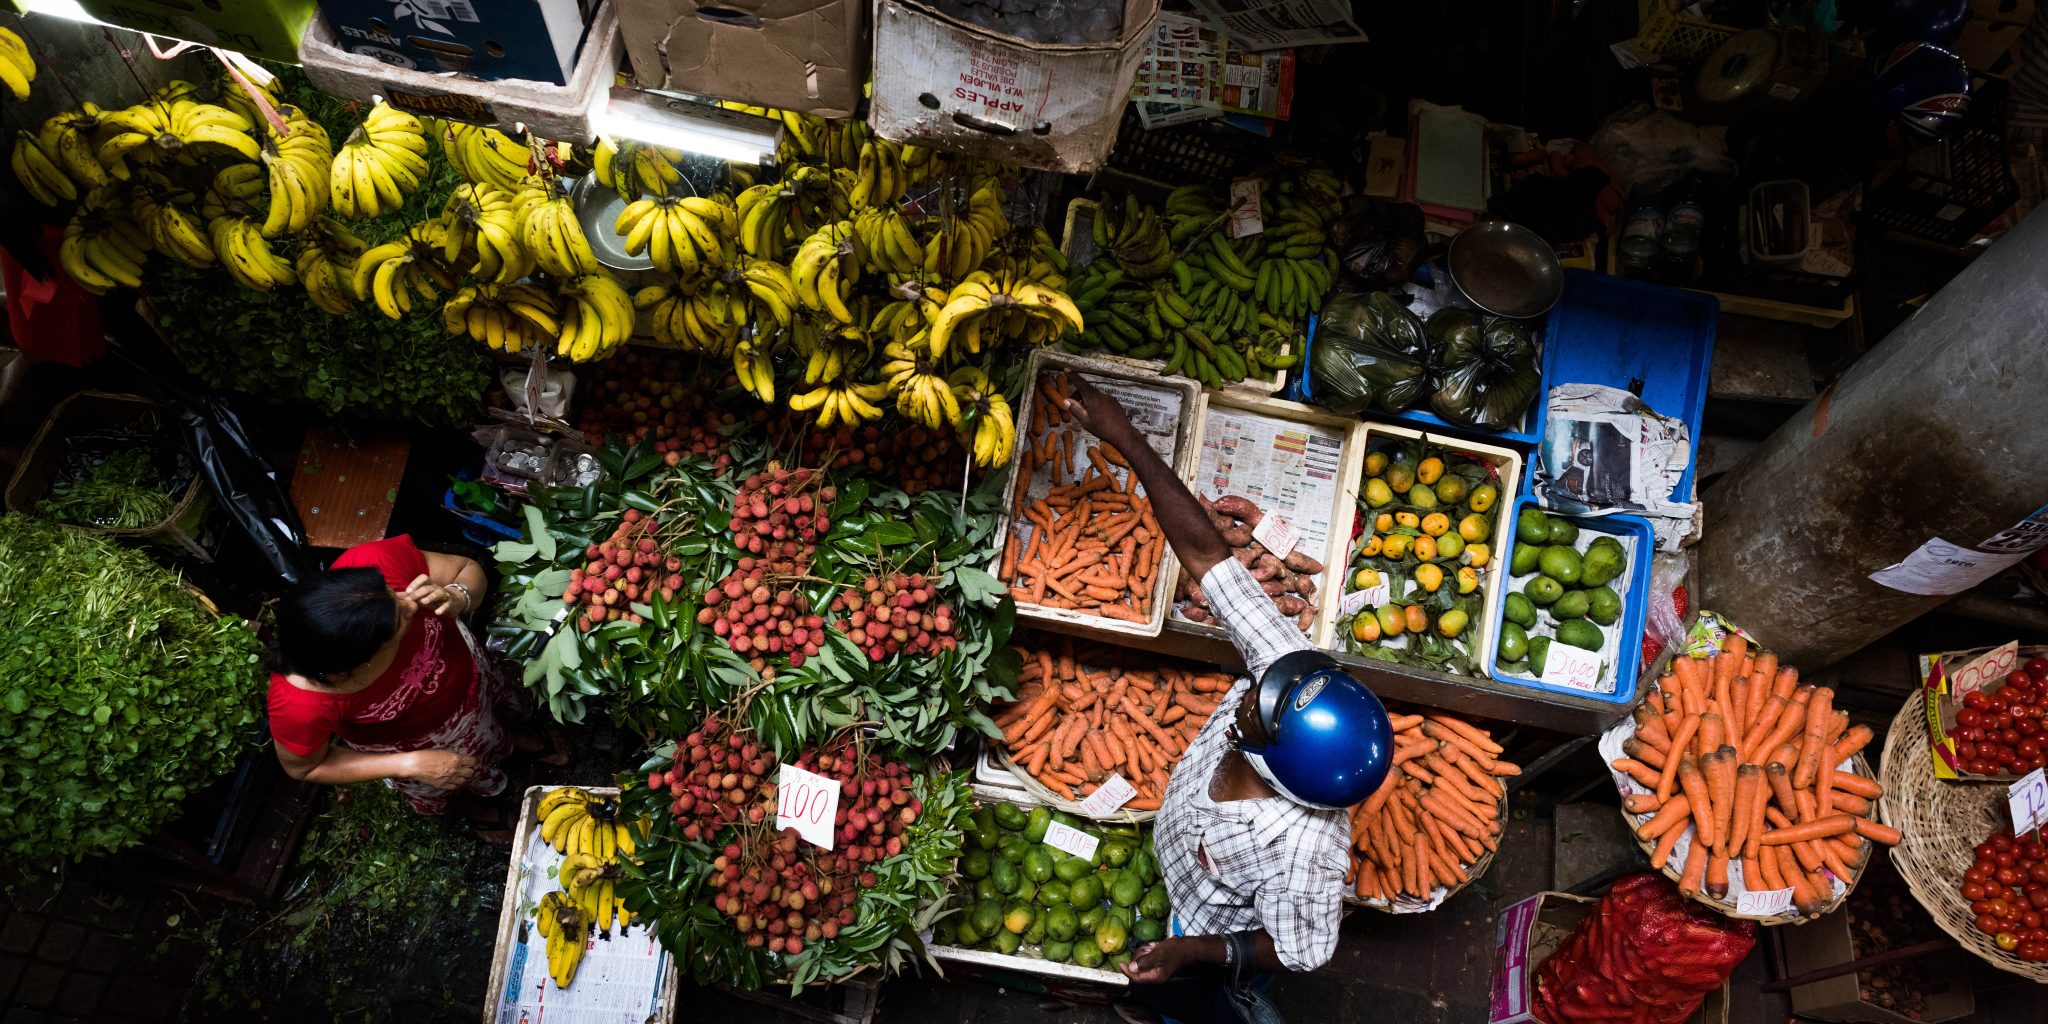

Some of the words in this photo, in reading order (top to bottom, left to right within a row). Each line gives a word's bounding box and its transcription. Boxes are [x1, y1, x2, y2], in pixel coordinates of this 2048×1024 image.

[340, 24, 402, 47] APPLES
[997, 48, 1007, 58] of
[1008, 50, 1041, 66] Produce
[970, 58, 980, 68] 70
[981, 62, 1017, 78] POSBUS
[991, 55, 1018, 70] ELGIN
[959, 72, 1001, 94] VILJOEN
[999, 74, 1015, 86] DIE
[1002, 84, 1023, 98] W.P.
[954, 86, 1025, 113] APPLES
[1929, 689, 1943, 743] SHARON
